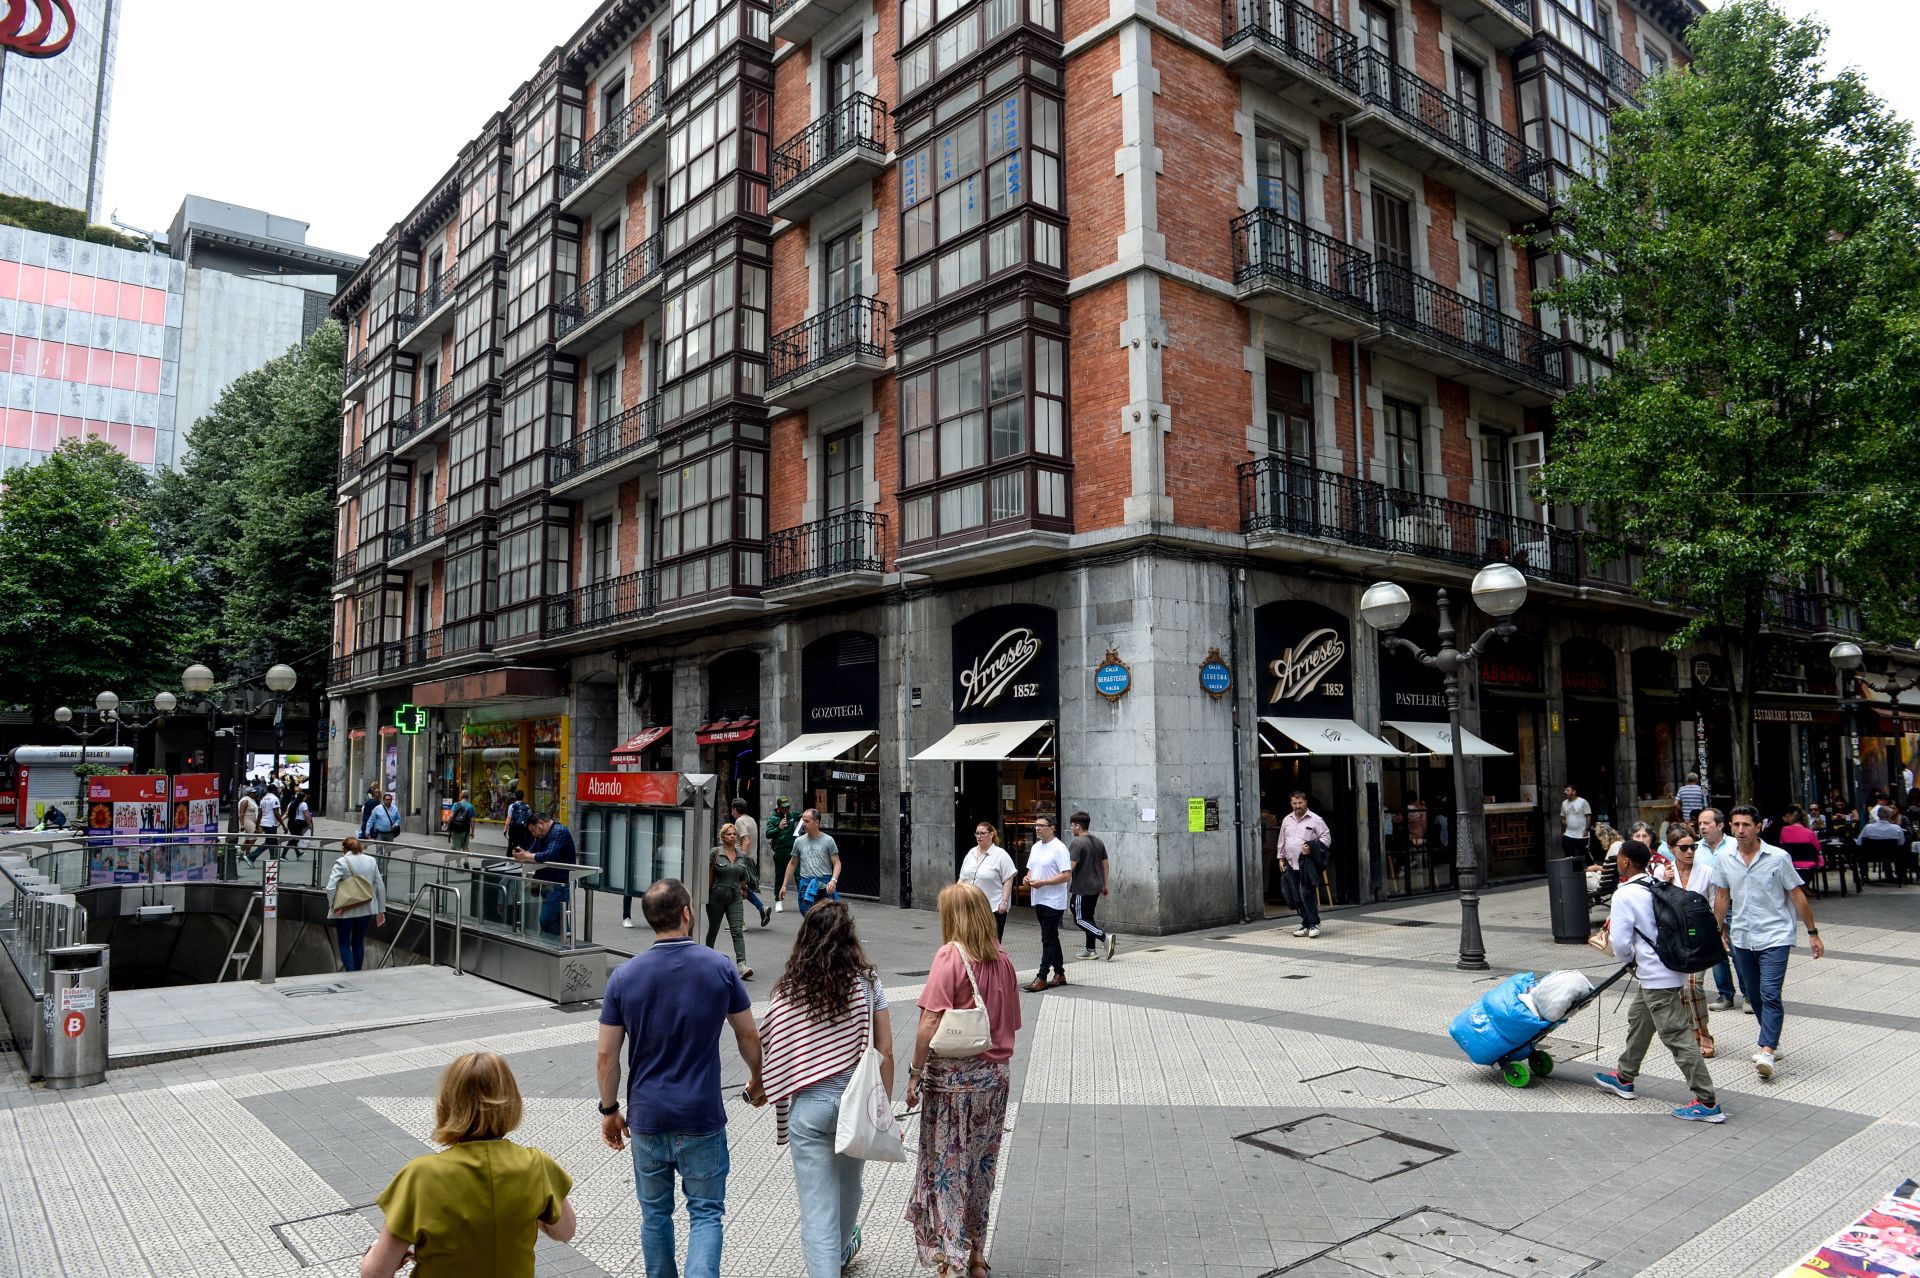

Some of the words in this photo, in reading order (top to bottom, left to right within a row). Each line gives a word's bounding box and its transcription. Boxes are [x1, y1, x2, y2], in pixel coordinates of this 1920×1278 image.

[943, 137, 952, 181] ALEN
[1097, 675, 1127, 683] BERASTEGUI
[1203, 673, 1227, 681] LEDESMA
[1481, 663, 1535, 685] ABERNA
[1562, 672, 1608, 689] AURINA
[1013, 683, 1036, 698] 1852
[1325, 682, 1344, 696] 1852
[1395, 691, 1446, 708] PASTELERÍA
[811, 704, 863, 719] GOZOTEGIA
[1754, 708, 1788, 721] ESTAURANTE
[415, 714, 423, 725] F
[587, 777, 622, 796] Abando
